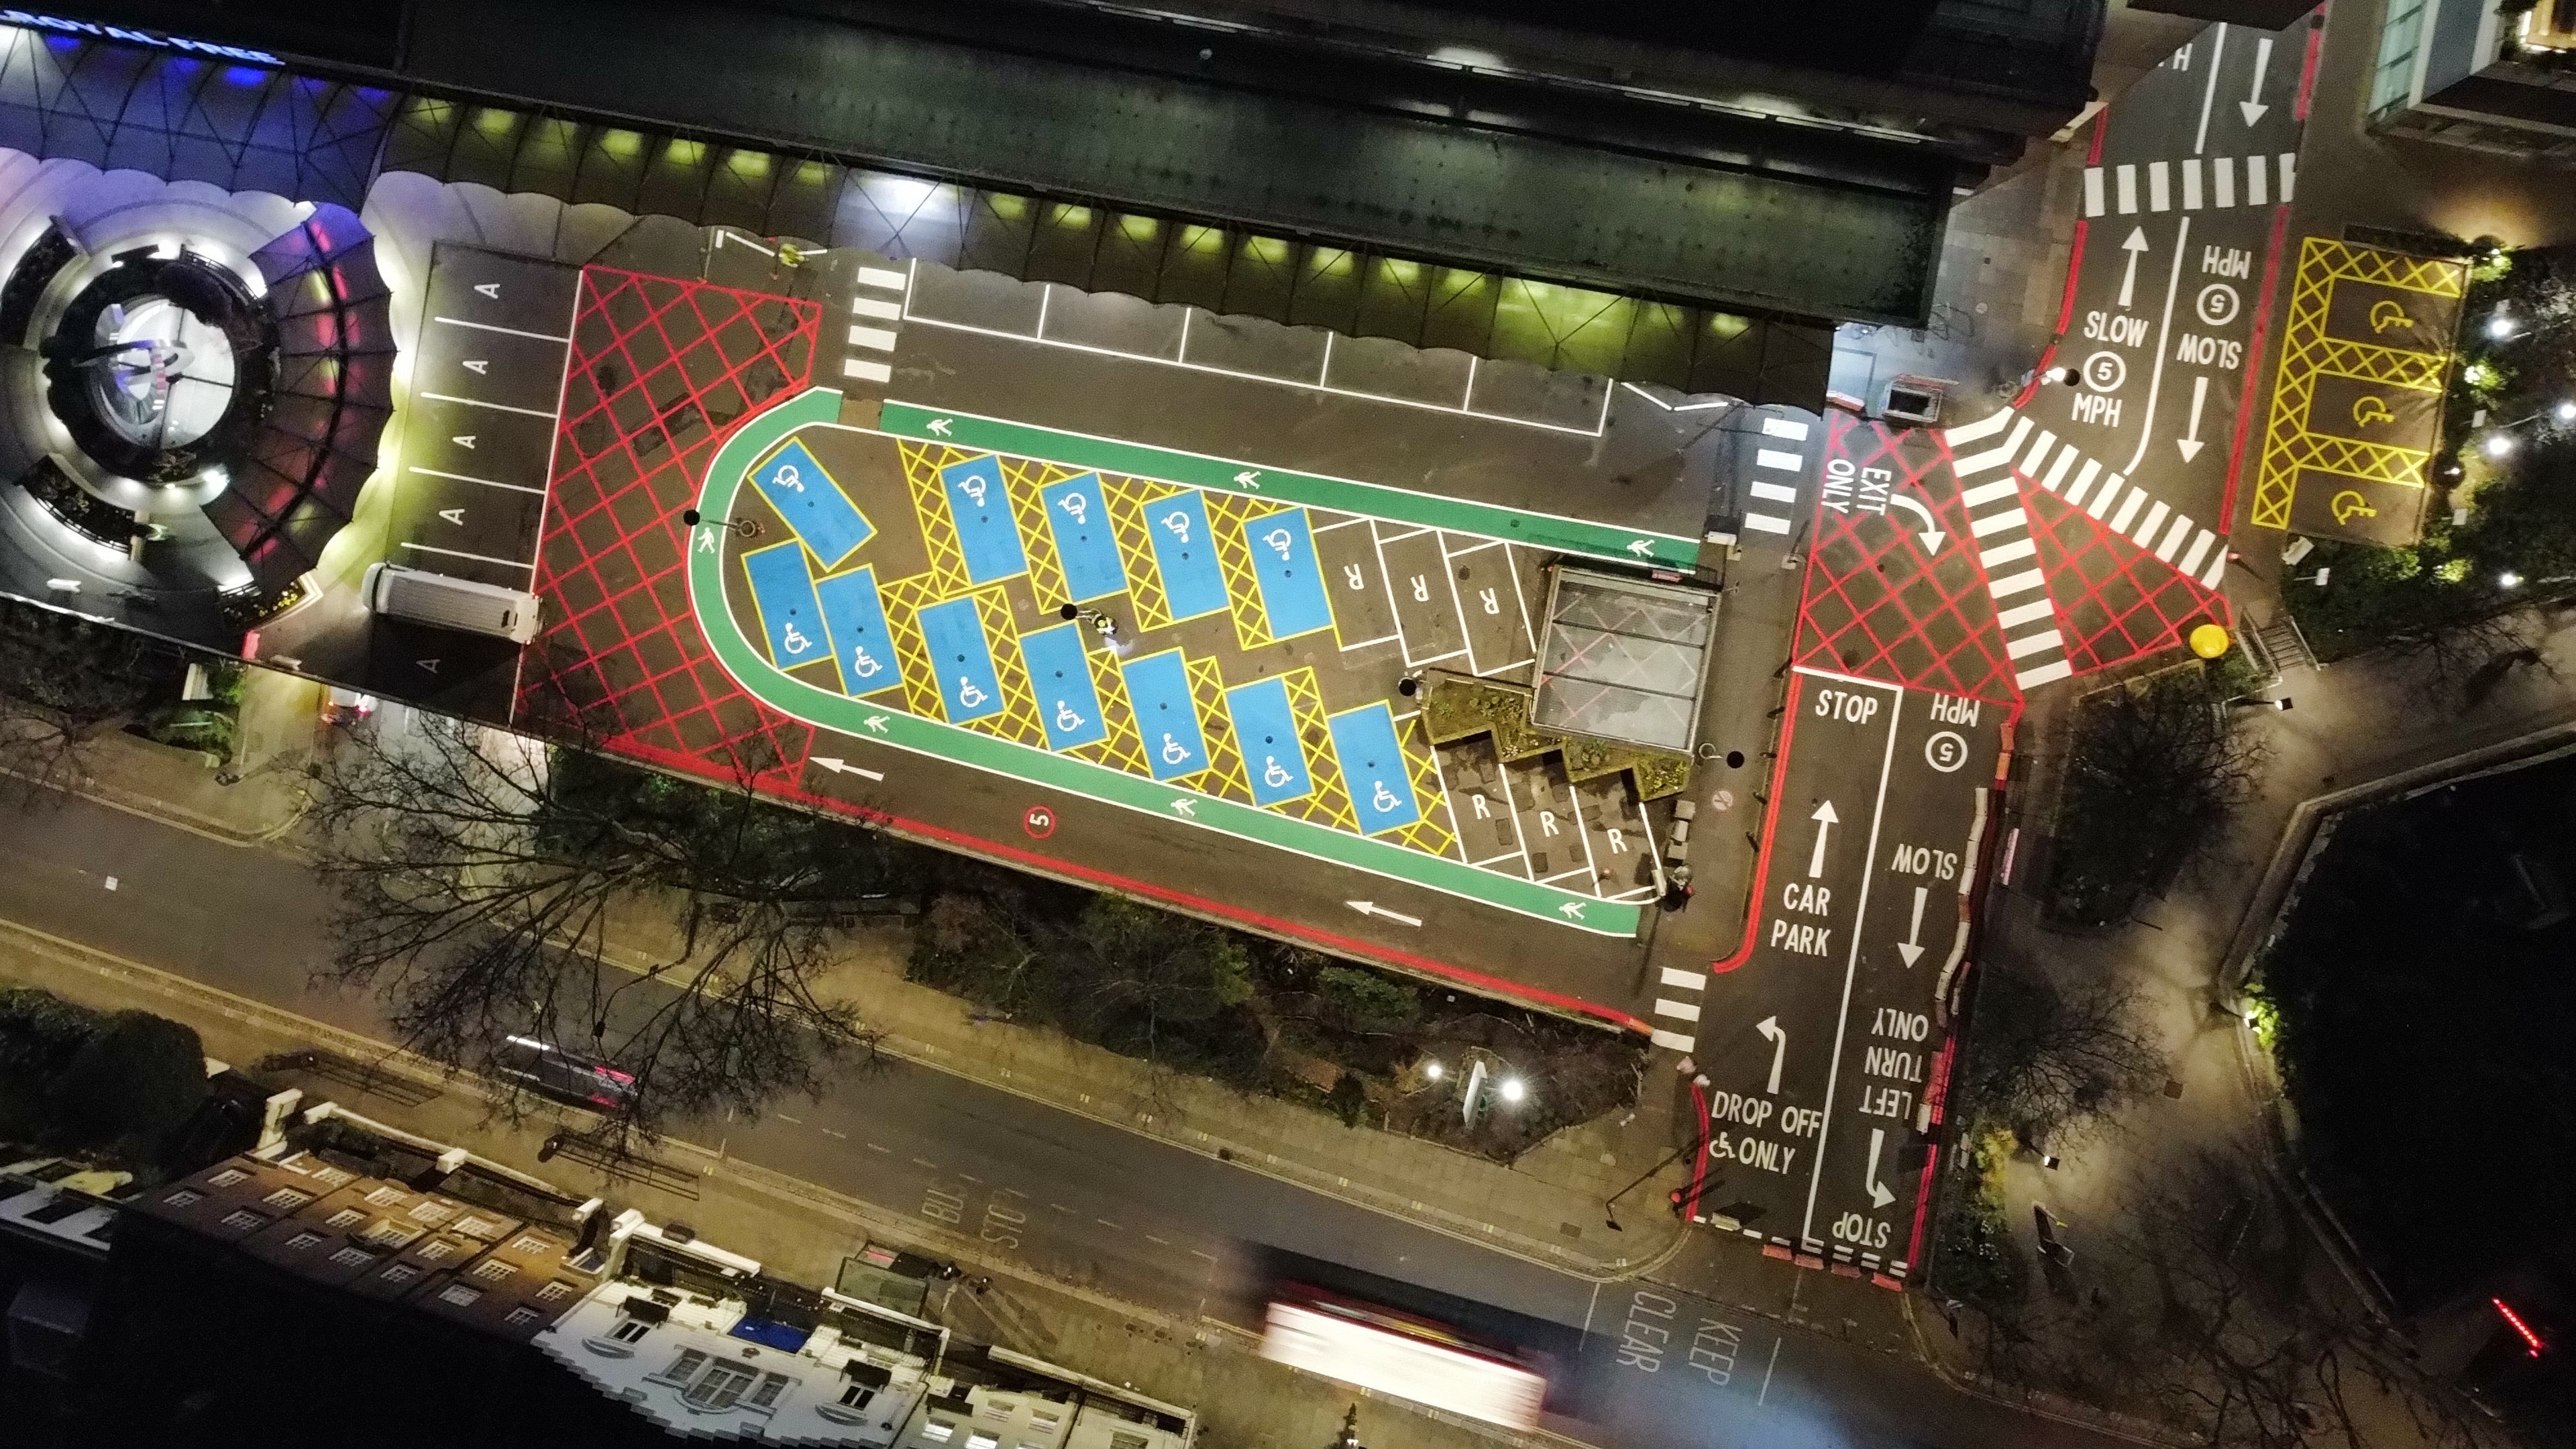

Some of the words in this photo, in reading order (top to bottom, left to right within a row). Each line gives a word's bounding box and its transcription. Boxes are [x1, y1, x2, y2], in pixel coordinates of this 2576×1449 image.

[2202, 245, 2251, 279] MPH
[474, 283, 500, 299] A
[2210, 294, 2225, 313] 5
[2083, 310, 2149, 347] SLOW
[462, 360, 488, 374] A
[2176, 333, 2243, 370] SLOW
[2097, 362, 2113, 381] 5
[2072, 392, 2123, 427] MPH
[453, 435, 476, 449] A
[1821, 458, 1856, 514] ONLY
[1856, 466, 1892, 516] EXIT
[439, 508, 466, 526] A
[1344, 563, 1364, 590] R
[1410, 574, 1430, 602] R
[1479, 588, 1500, 614] R
[417, 659, 441, 674] A
[1815, 690, 1878, 724] STOP
[1930, 694, 1980, 727] MPH
[1939, 743, 1954, 761] 5
[1029, 813, 1049, 826] 5
[1471, 794, 1491, 820] R
[1540, 811, 1560, 837] R
[1607, 828, 1627, 854] R
[1891, 843, 1957, 880] SLOW
[1783, 883, 1831, 916] CAR
[1771, 919, 1831, 956] PARK
[1871, 1008, 1929, 1042] ONLY
[1864, 1046, 1923, 1083] TURN
[1711, 1091, 1773, 1128] DROP
[1781, 1106, 1823, 1138] OFF
[1859, 1085, 1912, 1120] LEFT
[1739, 1137, 1796, 1175] ONLY
[1832, 1211, 1891, 1248] STOP
[1615, 1291, 1677, 1373] CLEAR
[1688, 1317, 1743, 1387] KEEP
